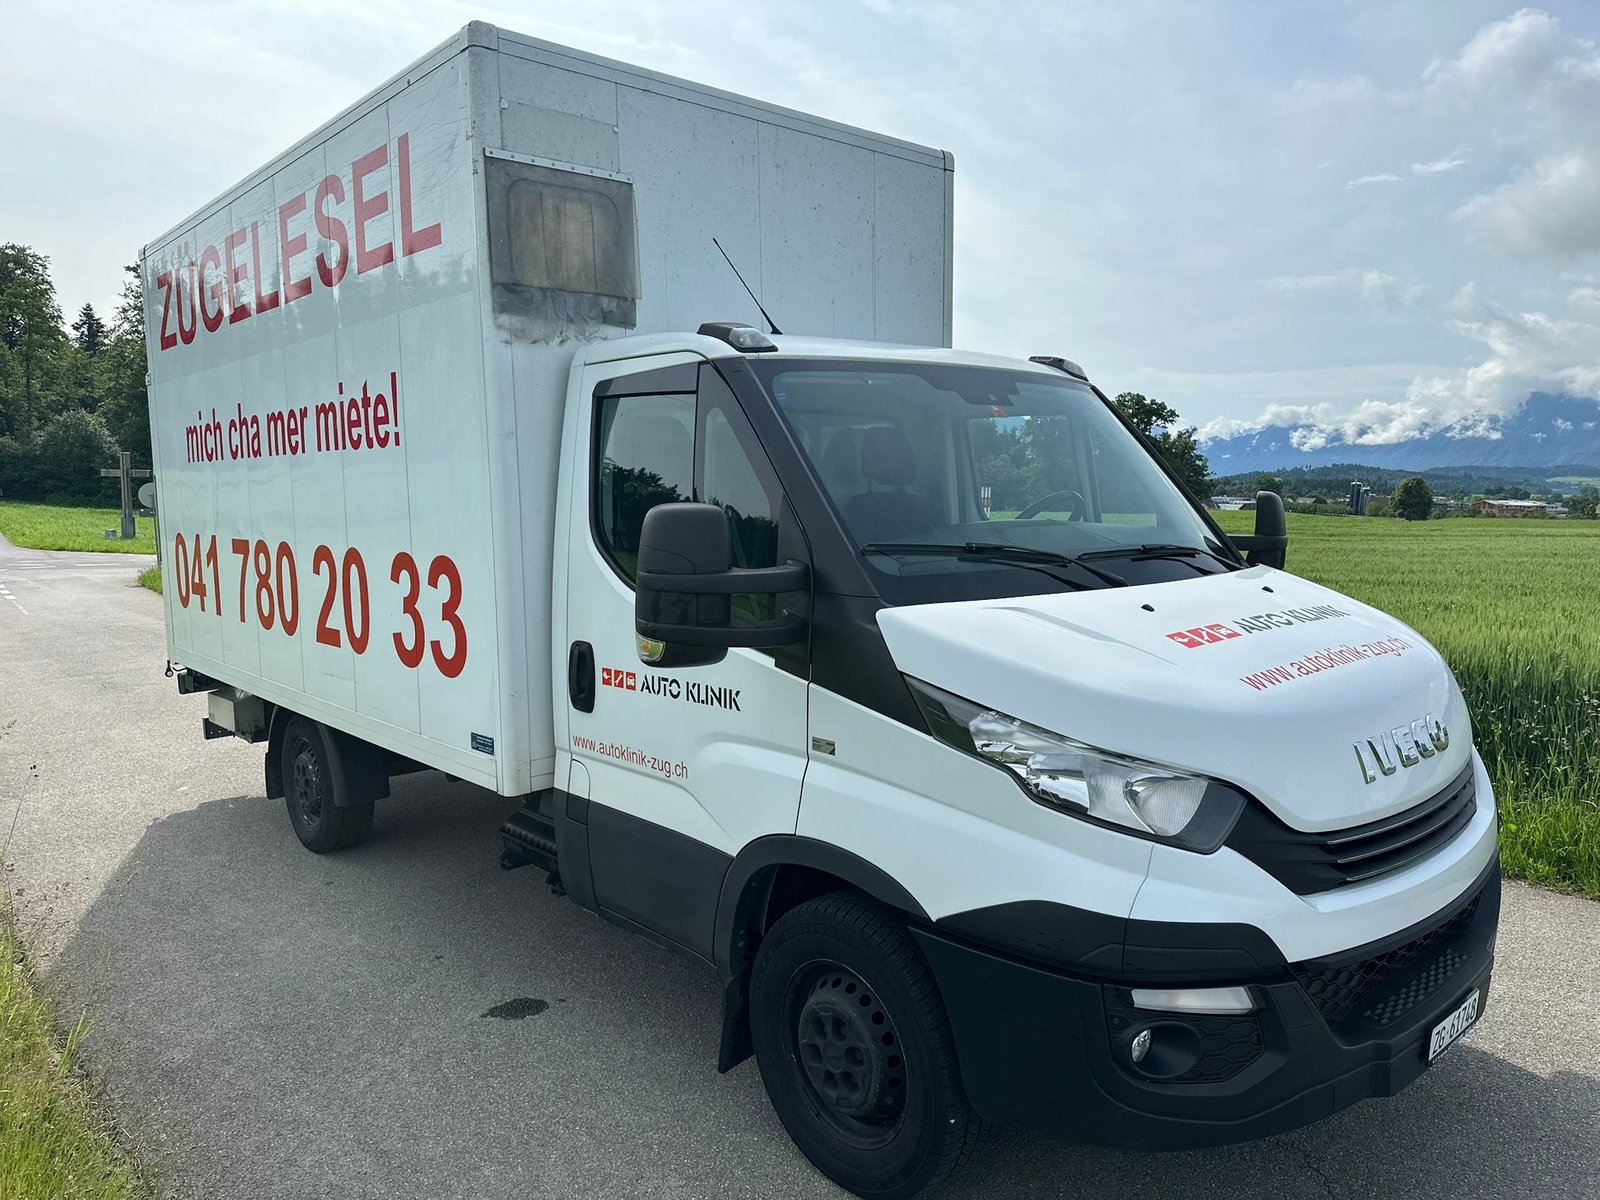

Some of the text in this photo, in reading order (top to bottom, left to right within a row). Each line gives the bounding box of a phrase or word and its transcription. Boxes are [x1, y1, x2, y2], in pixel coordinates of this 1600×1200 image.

[157, 132, 442, 351] ZÜGELESEL
[186, 372, 400, 463] mich cha mer miete!
[174, 532, 468, 679] 041 780 20 33
[1232, 604, 1351, 634] AUTO KLINIK
[640, 674, 741, 711] AUTO KLINIK
[1239, 634, 1413, 691] www.autoklinik-zug.ch
[573, 734, 688, 779] www.autoklinik-zug.ch
[1352, 712, 1449, 785] IVECO
